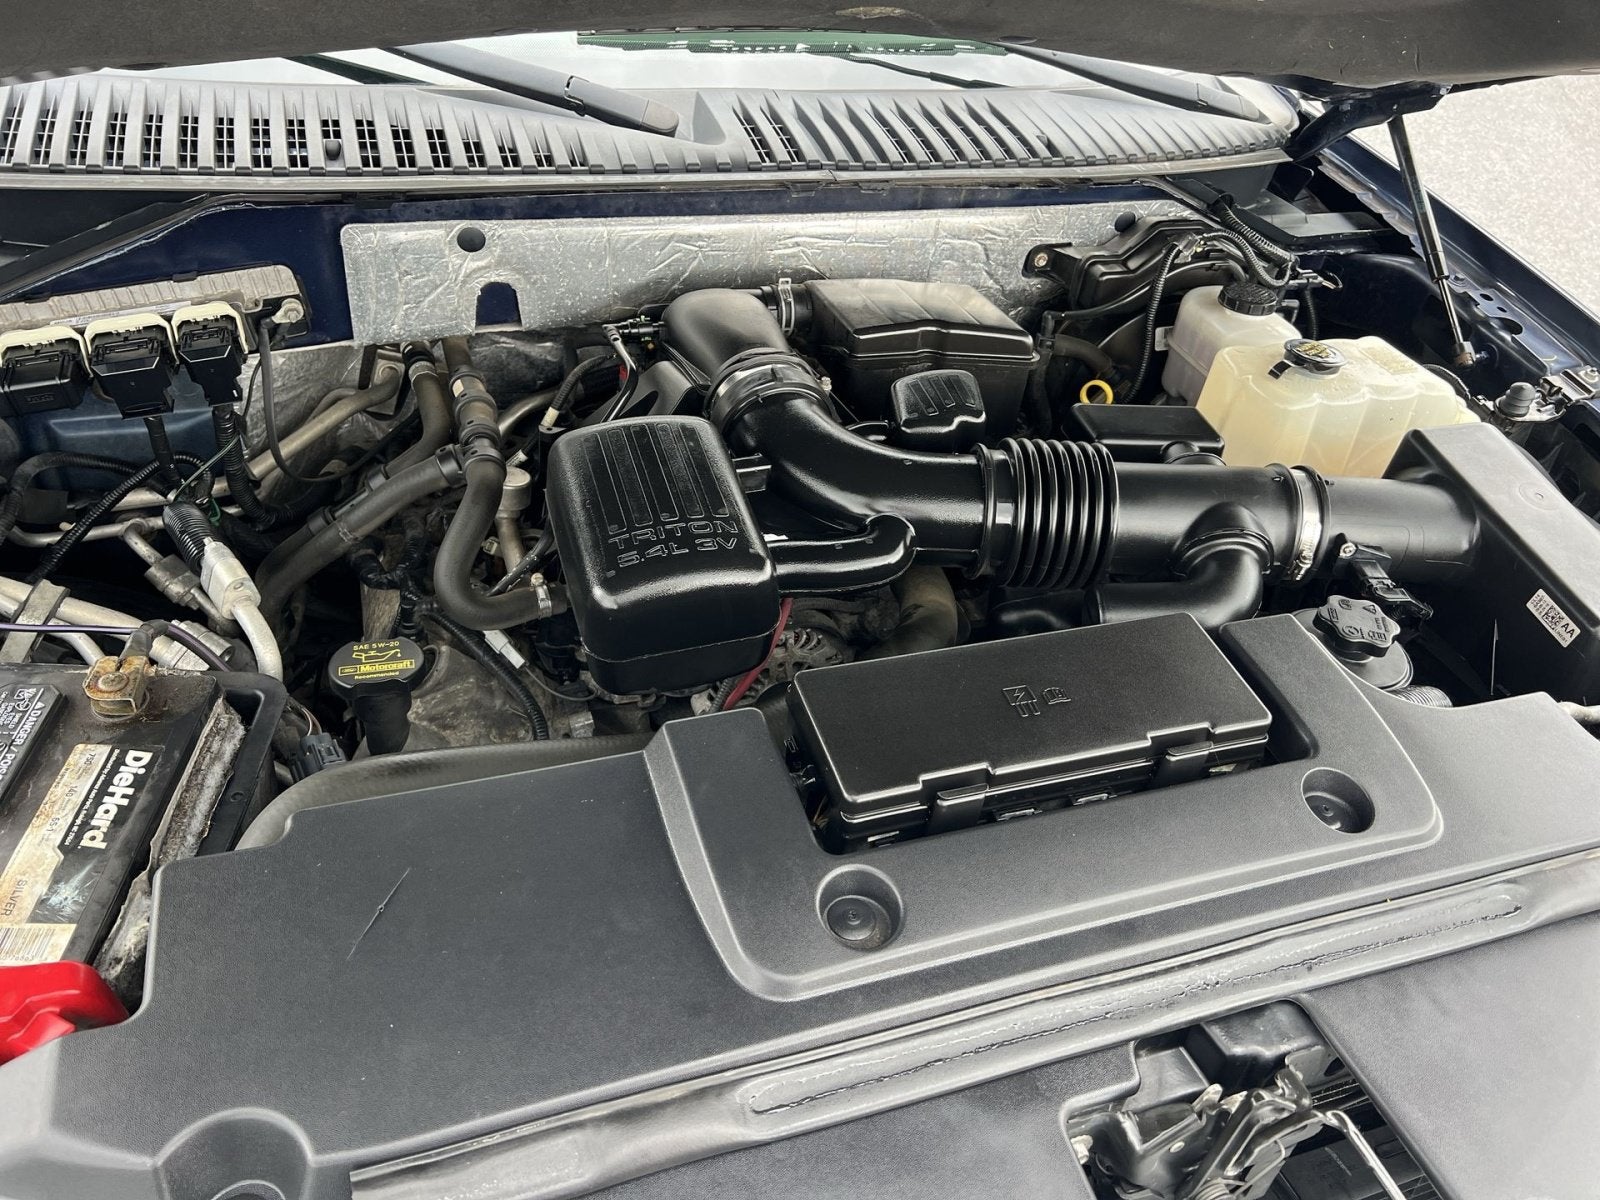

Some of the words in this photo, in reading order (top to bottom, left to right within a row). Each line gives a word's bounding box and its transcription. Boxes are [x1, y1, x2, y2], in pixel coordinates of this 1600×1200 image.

[608, 521, 739, 549] TRITON
[617, 542, 689, 568] 5.4L
[695, 537, 738, 551] 3V
[1561, 622, 1576, 638] AA
[360, 660, 411, 672] Motorcraft
[13, 710, 41, 745] DANGER
[0, 753, 15, 779] POIS
[0, 880, 28, 916] SILVER
